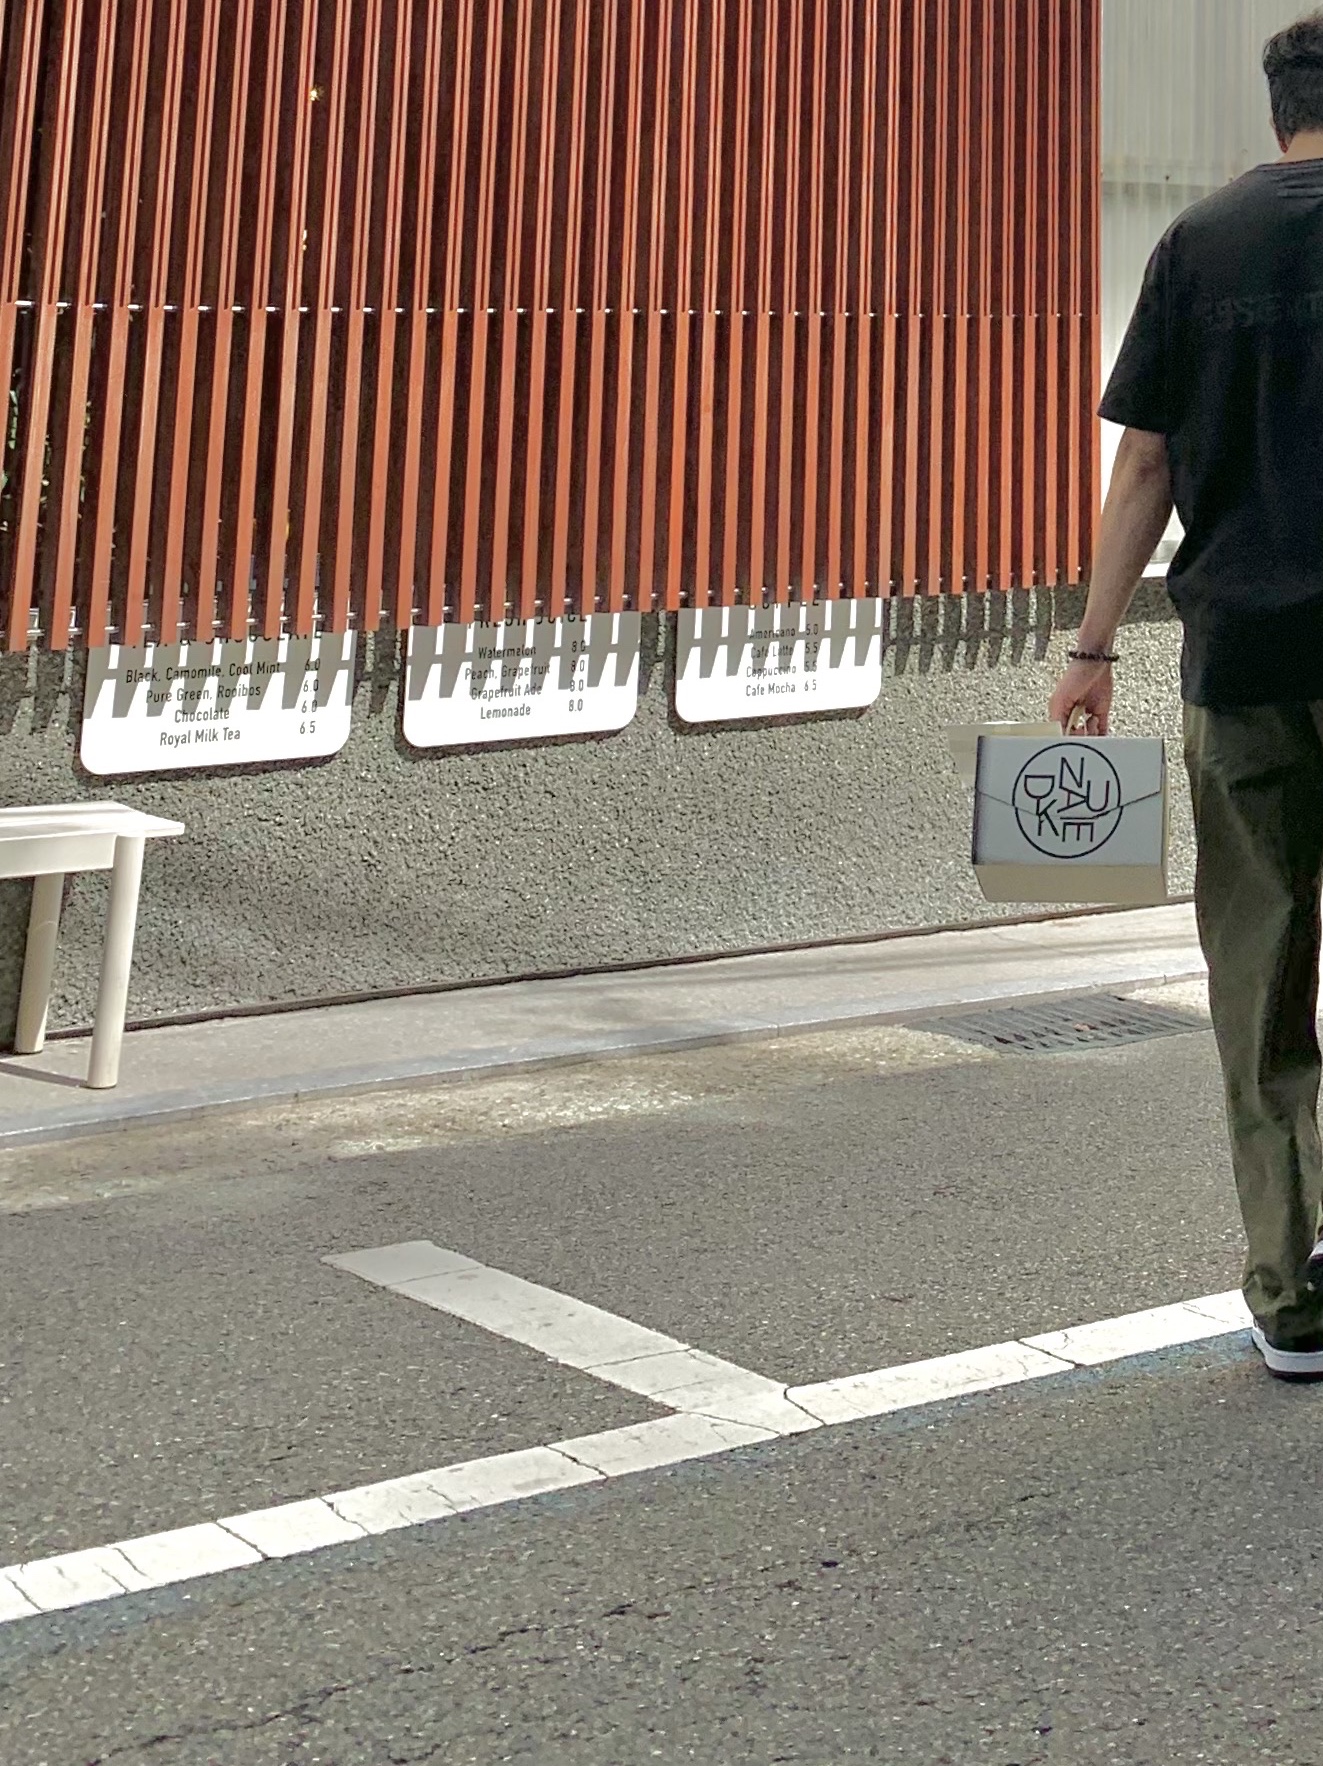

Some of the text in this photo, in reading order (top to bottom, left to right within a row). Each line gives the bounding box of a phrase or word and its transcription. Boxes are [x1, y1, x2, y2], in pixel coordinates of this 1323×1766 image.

[749, 623, 819, 640] Americano 5.0
[478, 644, 537, 659] Watermelon
[126, 658, 321, 684] Black, Camomile, Cool Mint 6.0
[465, 659, 585, 681] Peach, Grapefruit 8.0
[746, 665, 797, 680] Cappuccino
[146, 679, 319, 704] Pure Green, Rooibos 6.0
[471, 679, 584, 702] Grapefruit Ade 8.0
[745, 683, 765, 697] Cafe
[767, 681, 796, 695] Mocha
[174, 699, 318, 724] Chocolate 6.0
[480, 698, 583, 720] Lemonade 8.0
[159, 720, 316, 748] Royal Milk Tea 6.5
